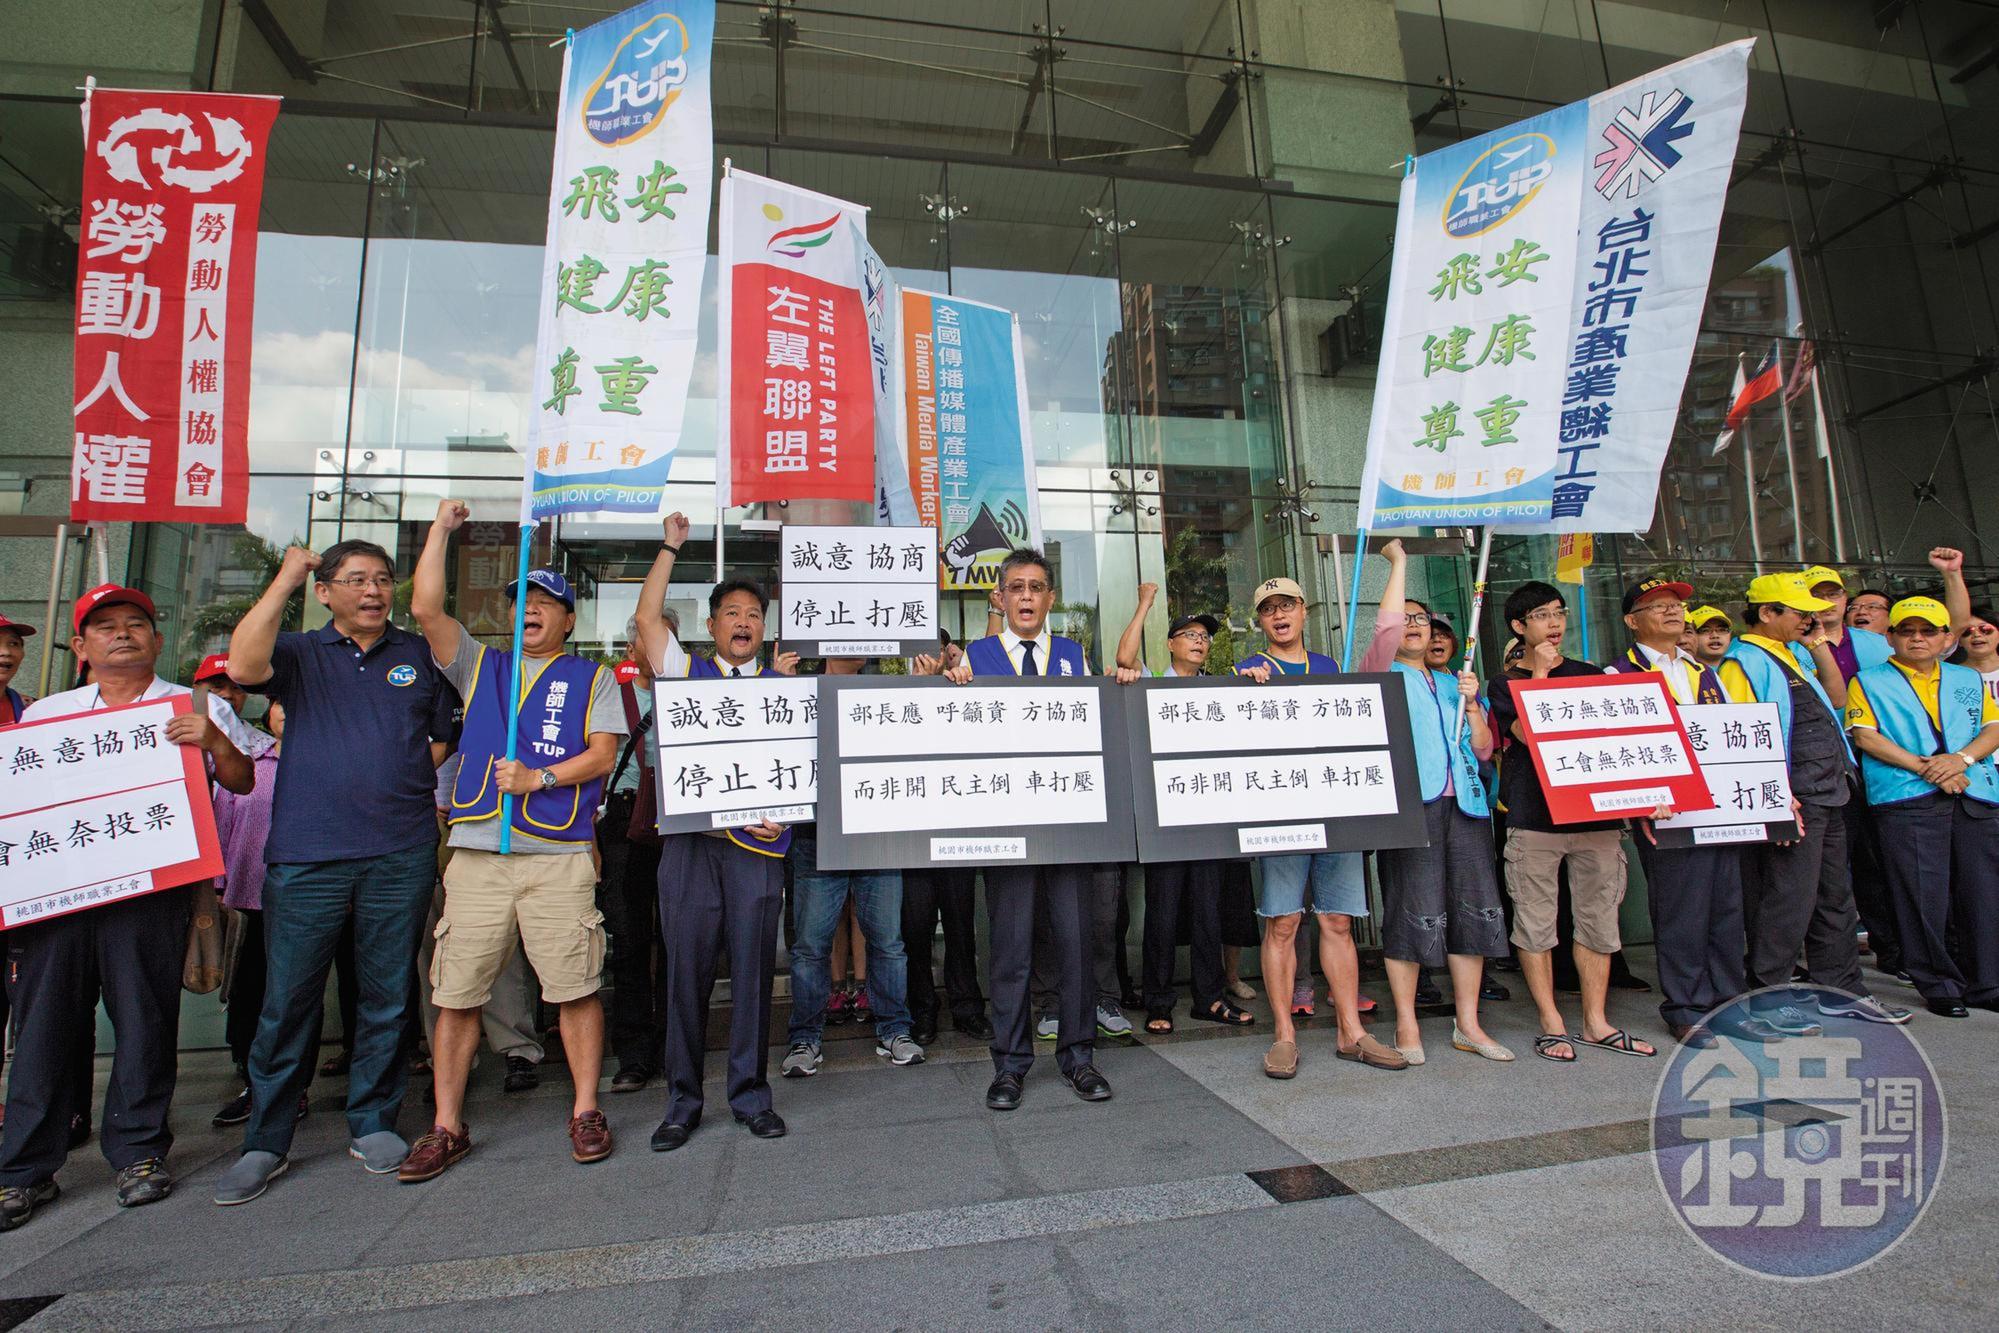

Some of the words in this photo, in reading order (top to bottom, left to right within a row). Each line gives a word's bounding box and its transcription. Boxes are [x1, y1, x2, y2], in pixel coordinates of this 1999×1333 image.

[562, 160, 687, 223] 飛安
[556, 254, 673, 322] 健康
[1428, 238, 1550, 303] 飛安
[818, 298, 835, 336] THE
[1421, 313, 1537, 378] 健康
[72, 199, 167, 504] 勞動人權
[183, 212, 227, 497] 勞動人權協會
[543, 346, 658, 416] 尊重
[763, 286, 811, 473] 左翼聯盟
[818, 341, 837, 392] LEFT
[915, 332, 933, 391] Taiwan
[819, 398, 837, 473] PARTY
[917, 395, 937, 451] Media
[935, 305, 972, 524] 全國傳播媒體產業工會
[1412, 394, 1528, 453] 尊重
[594, 488, 612, 501] OF
[616, 490, 657, 503] PILOT
[1402, 466, 1526, 491] 機師工會
[1380, 510, 1431, 522] TAOYUAN
[1435, 508, 1478, 519] UNION
[1482, 506, 1502, 517] OF
[1506, 504, 1544, 516] PILOT
[542, 680, 569, 742] 機師工會
[1535, 695, 1659, 724] 資方無意協商
[0, 723, 158, 775] 無意協商
[532, 741, 566, 758] TUP
[1555, 744, 1678, 773] 工會無奈投票
[1709, 779, 1786, 811] 打壓
[16, 878, 141, 918] 桃園市機師職業工會
